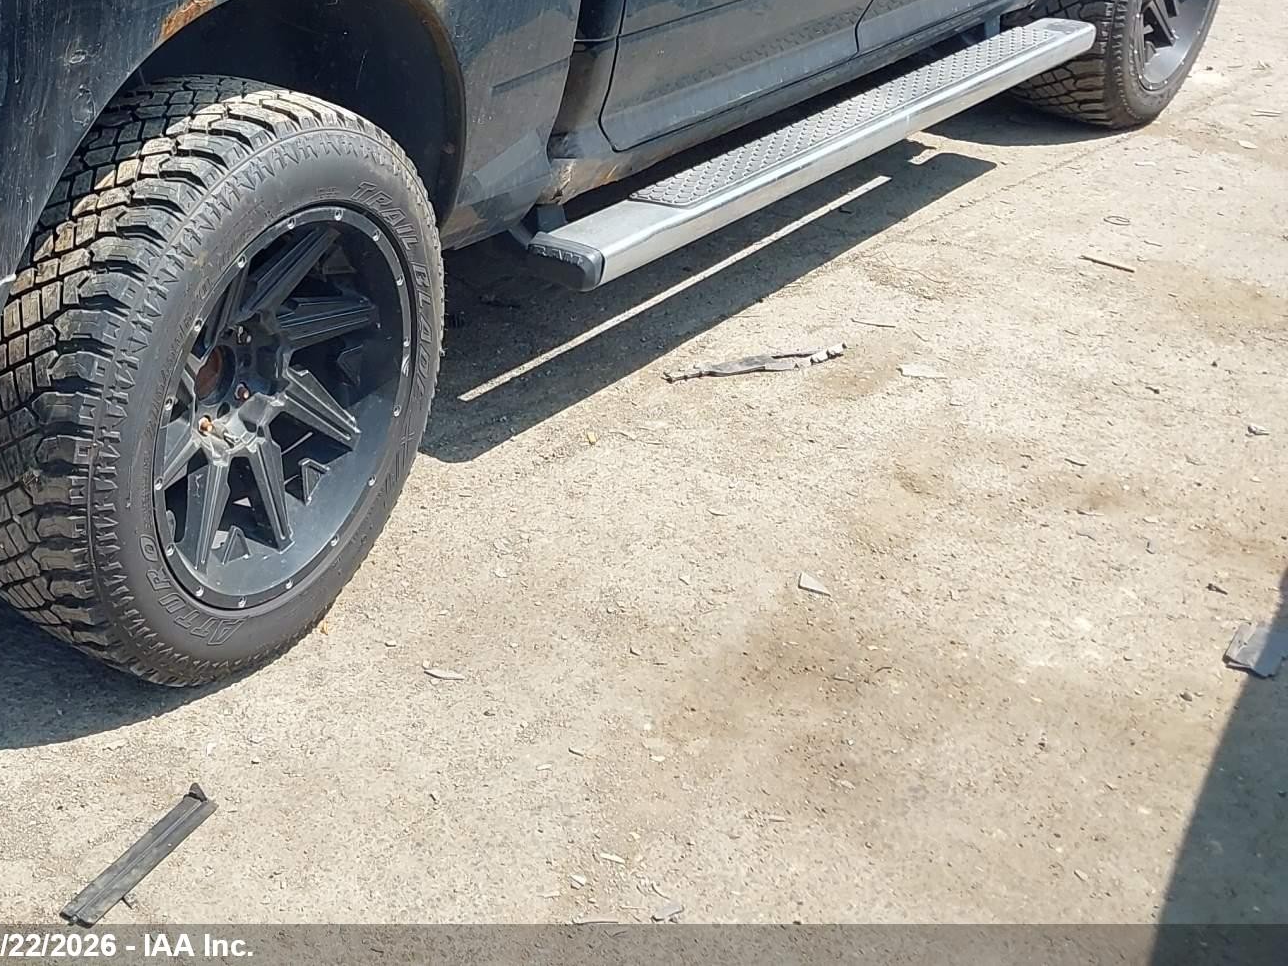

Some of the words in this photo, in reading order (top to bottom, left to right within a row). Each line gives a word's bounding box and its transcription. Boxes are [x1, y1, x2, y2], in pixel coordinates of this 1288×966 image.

[350, 181, 419, 251] TRAIL
[411, 261, 434, 400] BLADE
[139, 534, 247, 646] ATTURO
